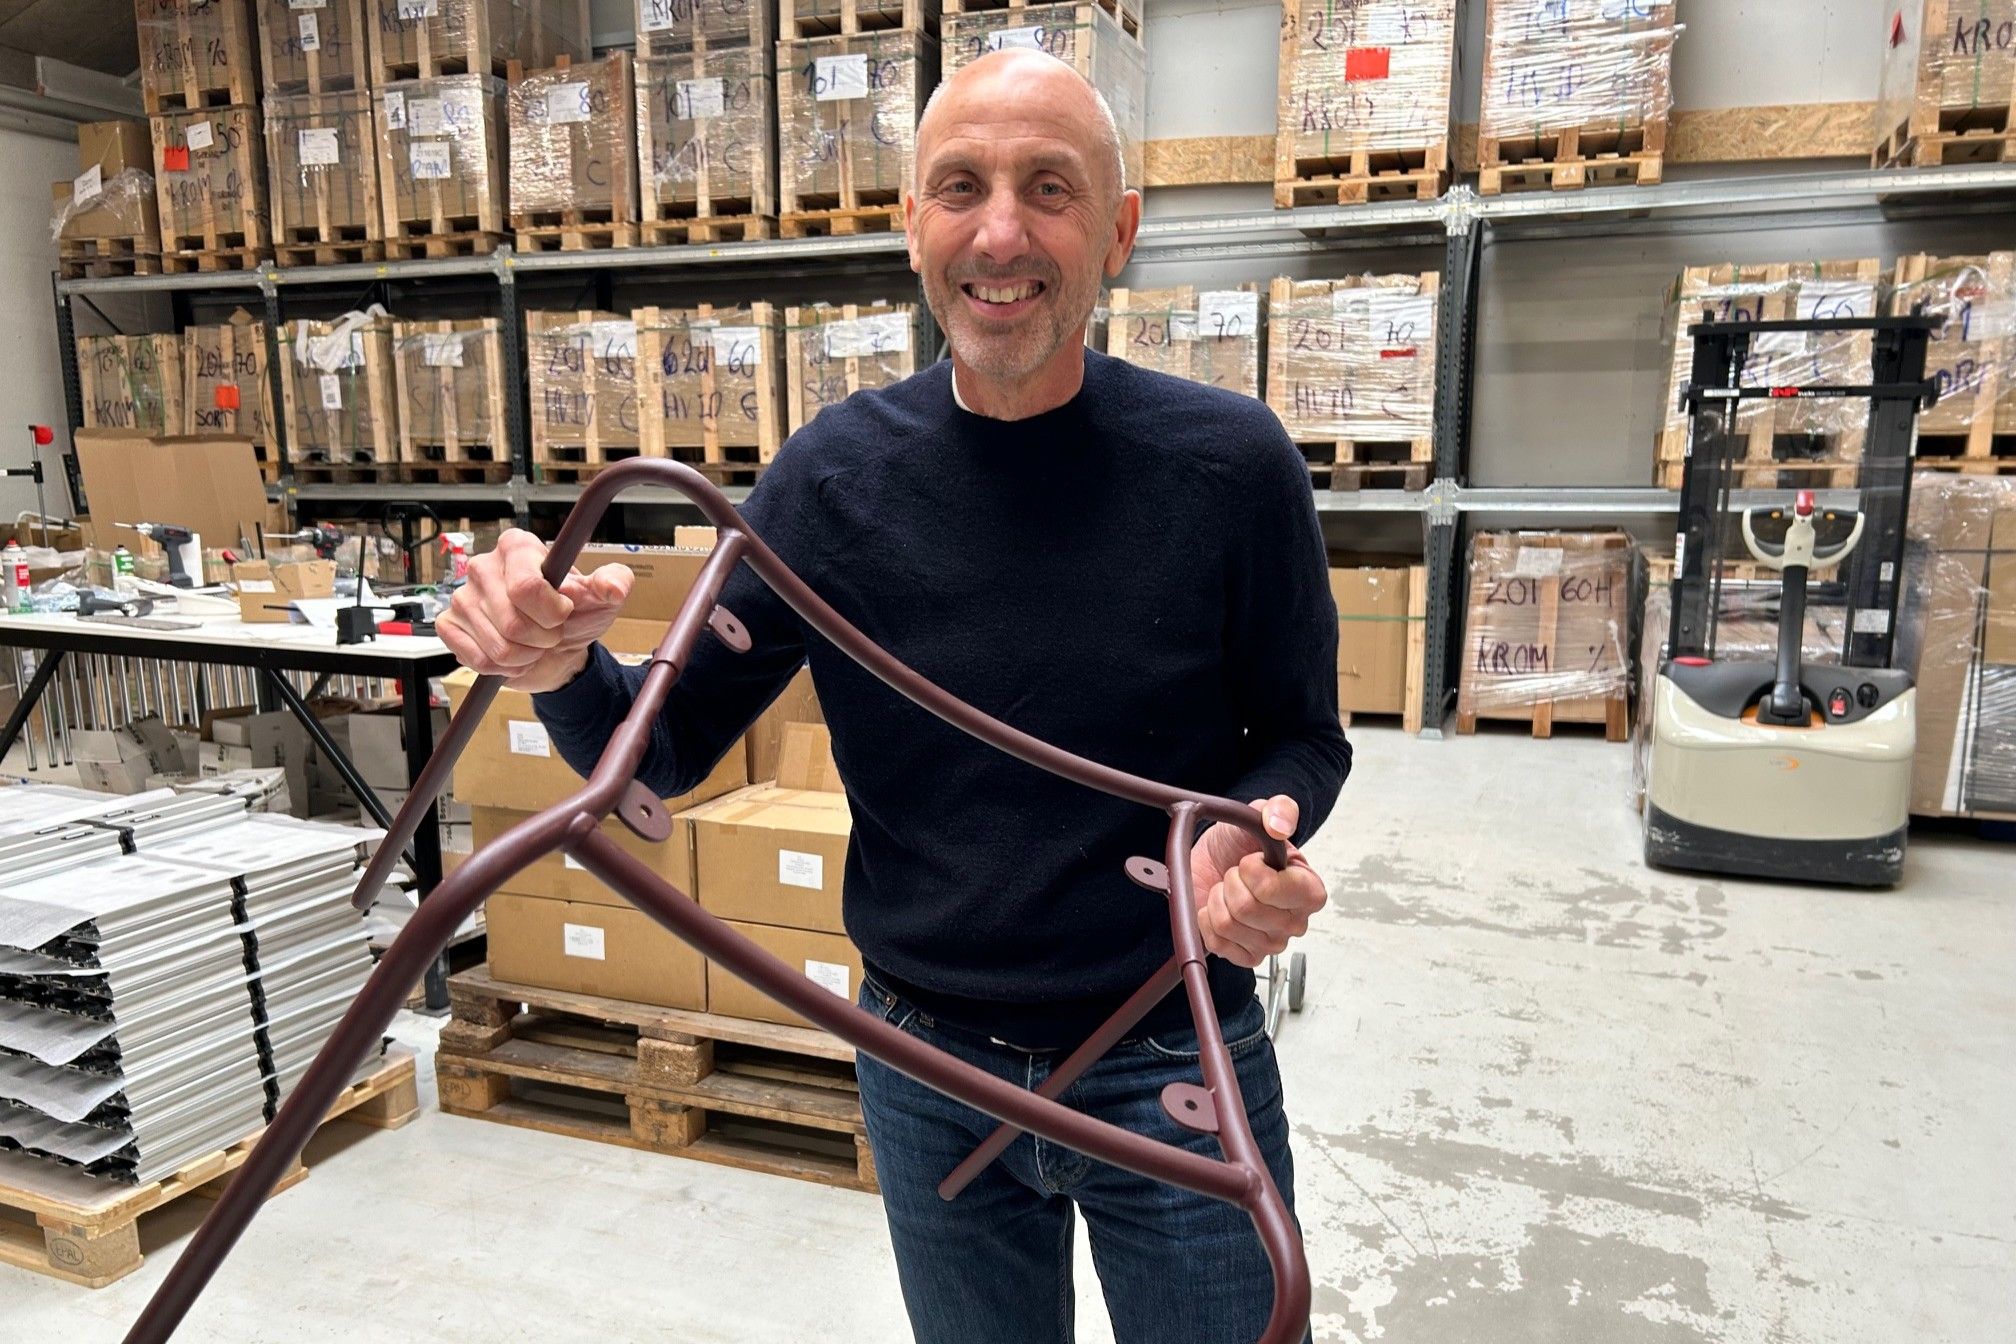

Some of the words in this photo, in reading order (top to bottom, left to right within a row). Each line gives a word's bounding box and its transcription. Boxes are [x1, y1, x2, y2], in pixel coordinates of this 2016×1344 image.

[1952, 16, 2016, 56] KRO
[1133, 315, 1173, 348] 201
[1210, 312, 1243, 343] 70
[1294, 319, 1346, 351] 201
[605, 337, 635, 380] 60
[728, 340, 756, 379] 60
[194, 408, 233, 429] SORT
[1486, 577, 1536, 606] 201
[1560, 575, 1614, 608] 60H
[1476, 635, 1549, 675] KROM
